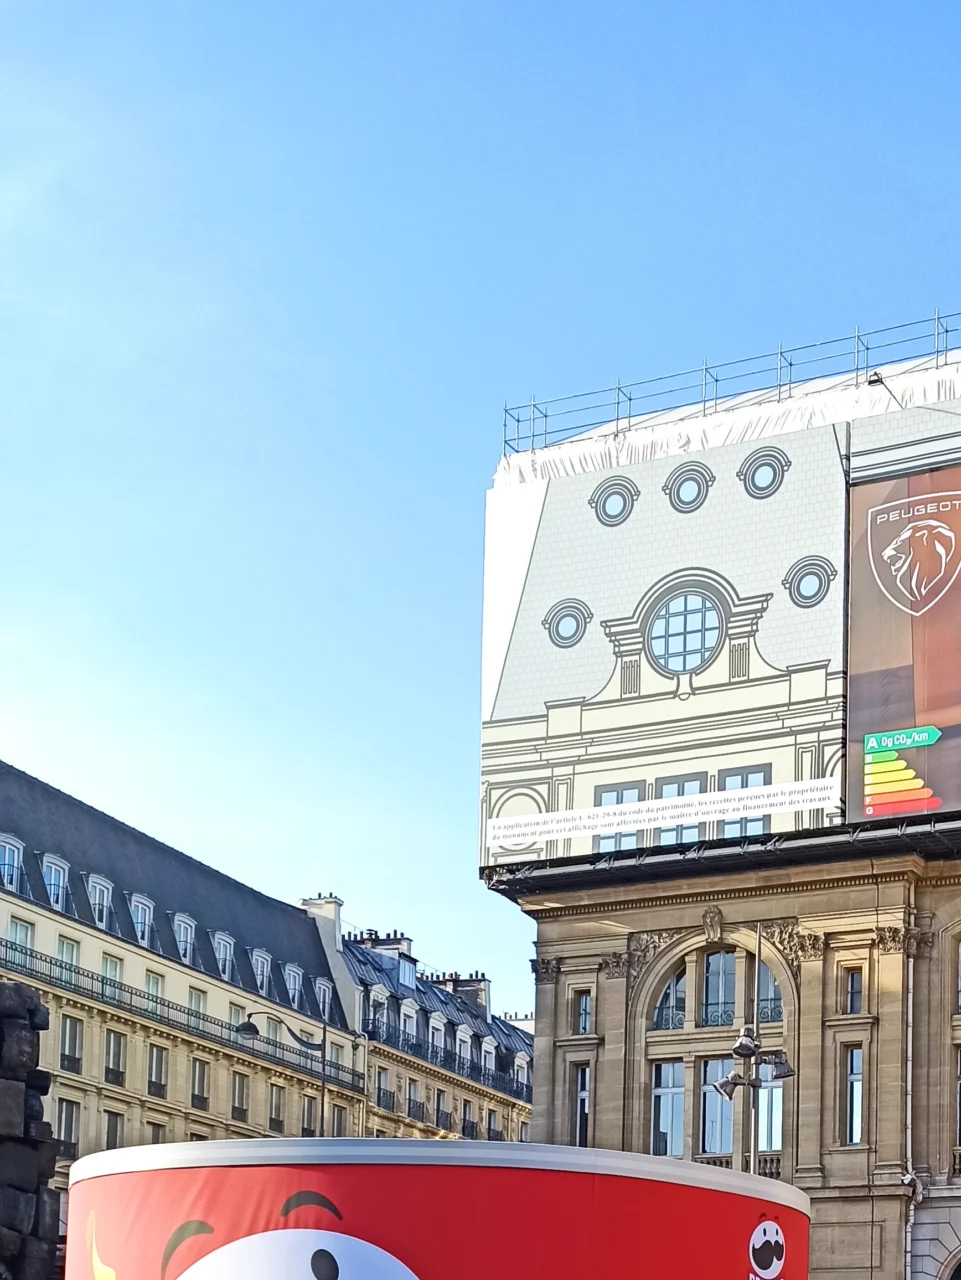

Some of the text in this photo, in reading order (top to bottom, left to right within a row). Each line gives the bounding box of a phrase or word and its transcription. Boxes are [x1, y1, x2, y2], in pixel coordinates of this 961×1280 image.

[866, 737, 879, 751] A
[492, 833, 501, 841] du
[502, 829, 537, 840] monument
[538, 828, 554, 838] pour
[567, 822, 599, 834] affichage
[600, 820, 614, 829] sont
[616, 817, 646, 828] affectées
[647, 816, 660, 825] par
[788, 798, 801, 806] des
[503, 819, 540, 831] application
[541, 818, 550, 826] de
[618, 809, 627, 817] du
[628, 807, 644, 816] code
[645, 806, 654, 814] du
[697, 799, 708, 807] les
[766, 791, 780, 800] par
[788, 784, 834, 797] propriétaire
[865, 807, 873, 815] G
